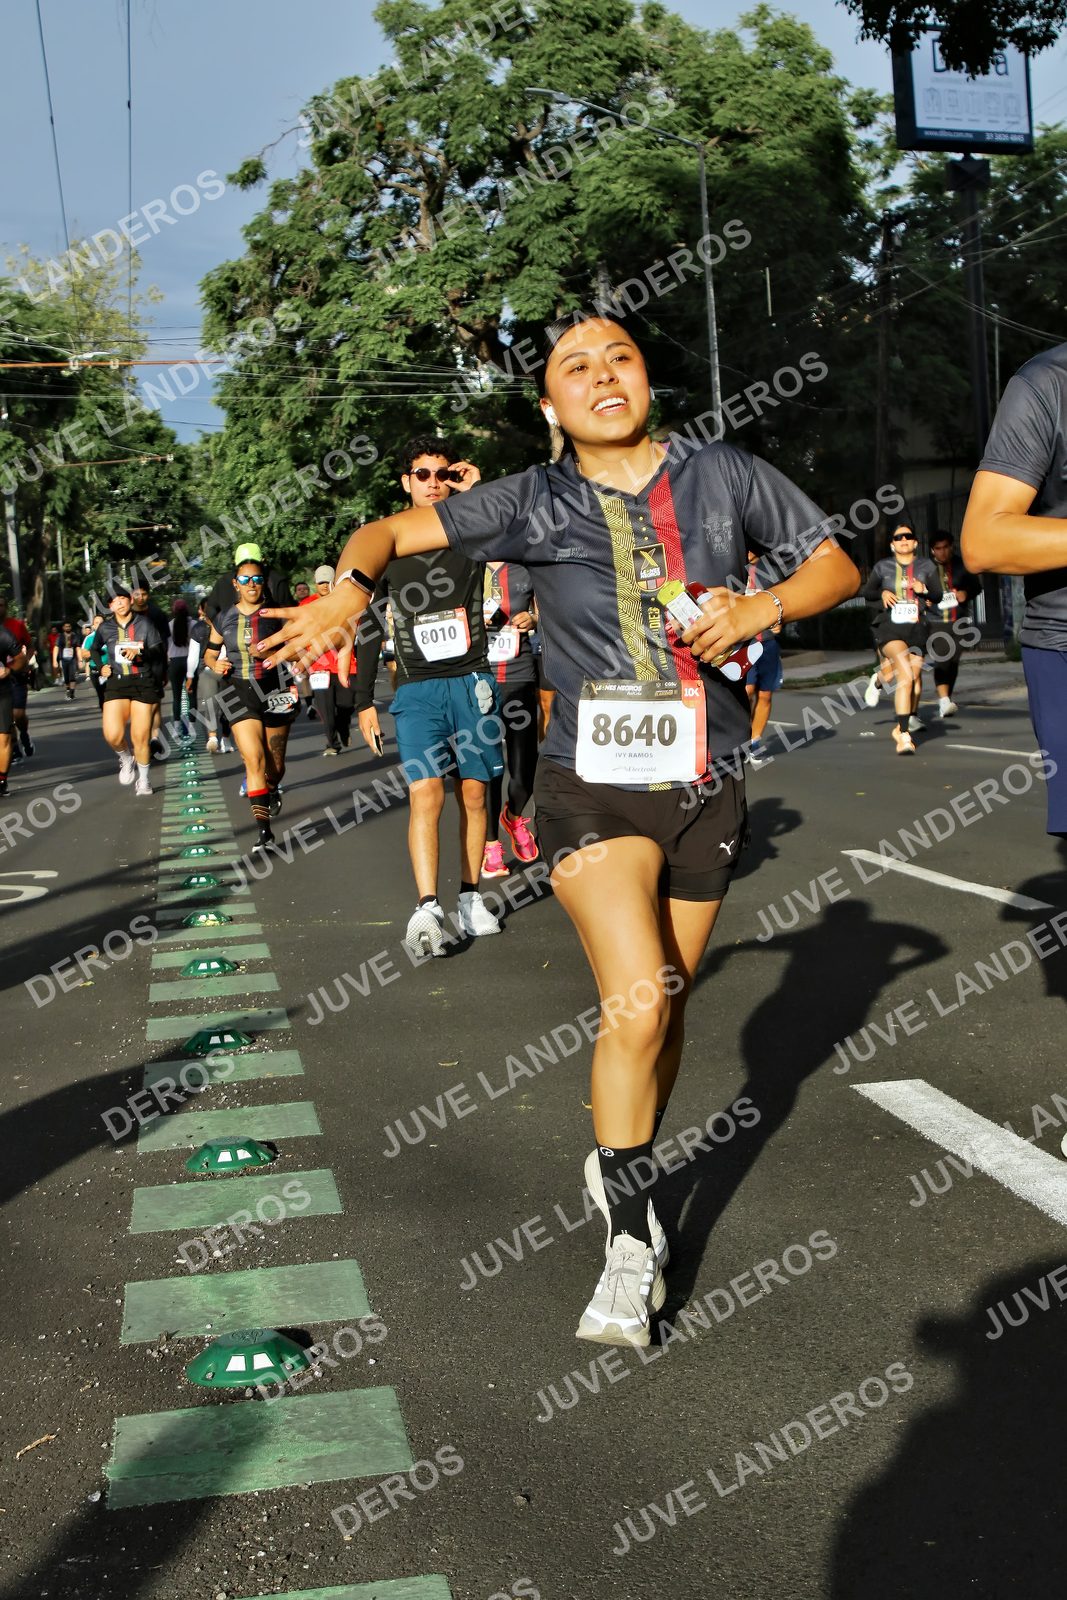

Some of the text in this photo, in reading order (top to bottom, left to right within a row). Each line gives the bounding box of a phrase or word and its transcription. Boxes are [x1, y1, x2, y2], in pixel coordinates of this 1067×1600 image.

[420, 625, 457, 645] 8010
[684, 687, 700, 697] 10K
[591, 713, 677, 746] 8640
